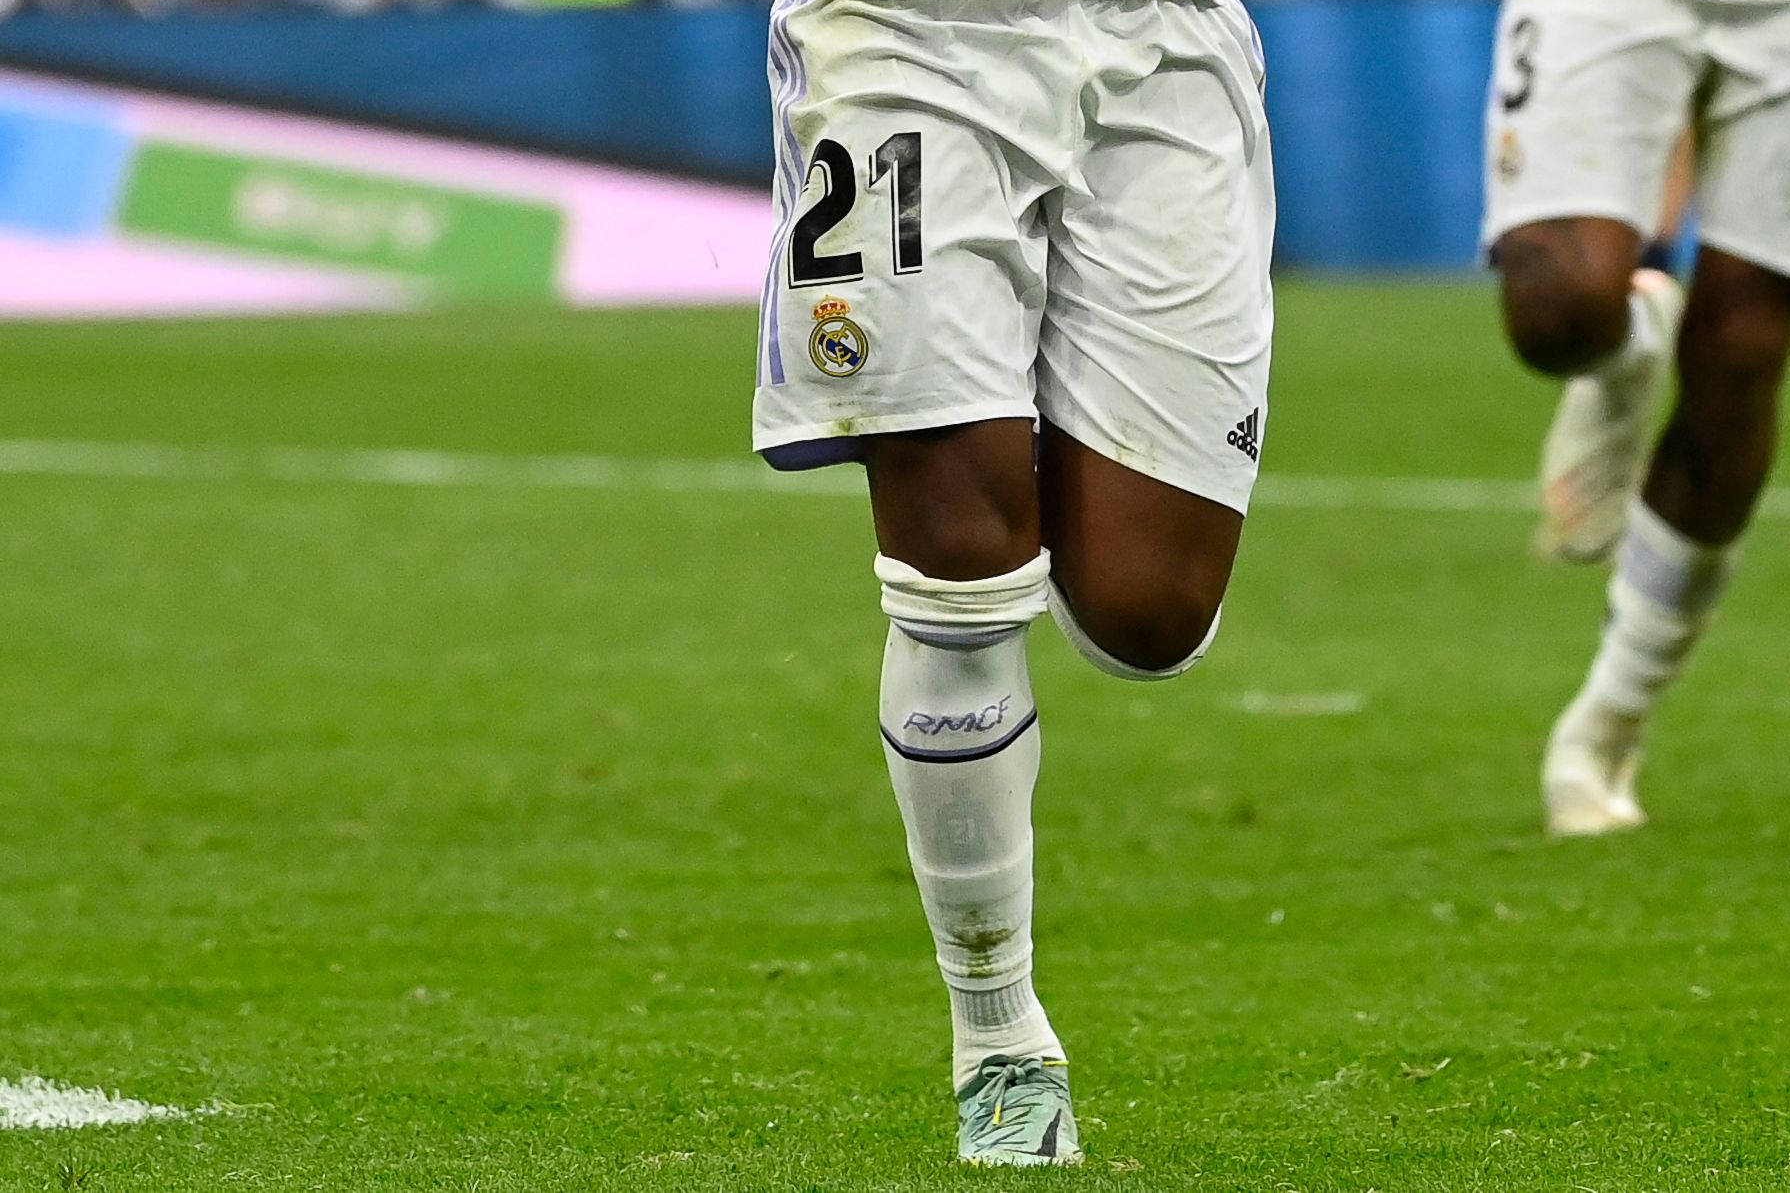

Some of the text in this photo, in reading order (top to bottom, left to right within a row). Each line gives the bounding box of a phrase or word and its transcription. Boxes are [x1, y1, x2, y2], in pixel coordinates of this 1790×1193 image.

[1502, 16, 1535, 112] 3
[788, 131, 923, 289] 21
[1226, 430, 1258, 463] adida
[903, 694, 1011, 735] RMCF
